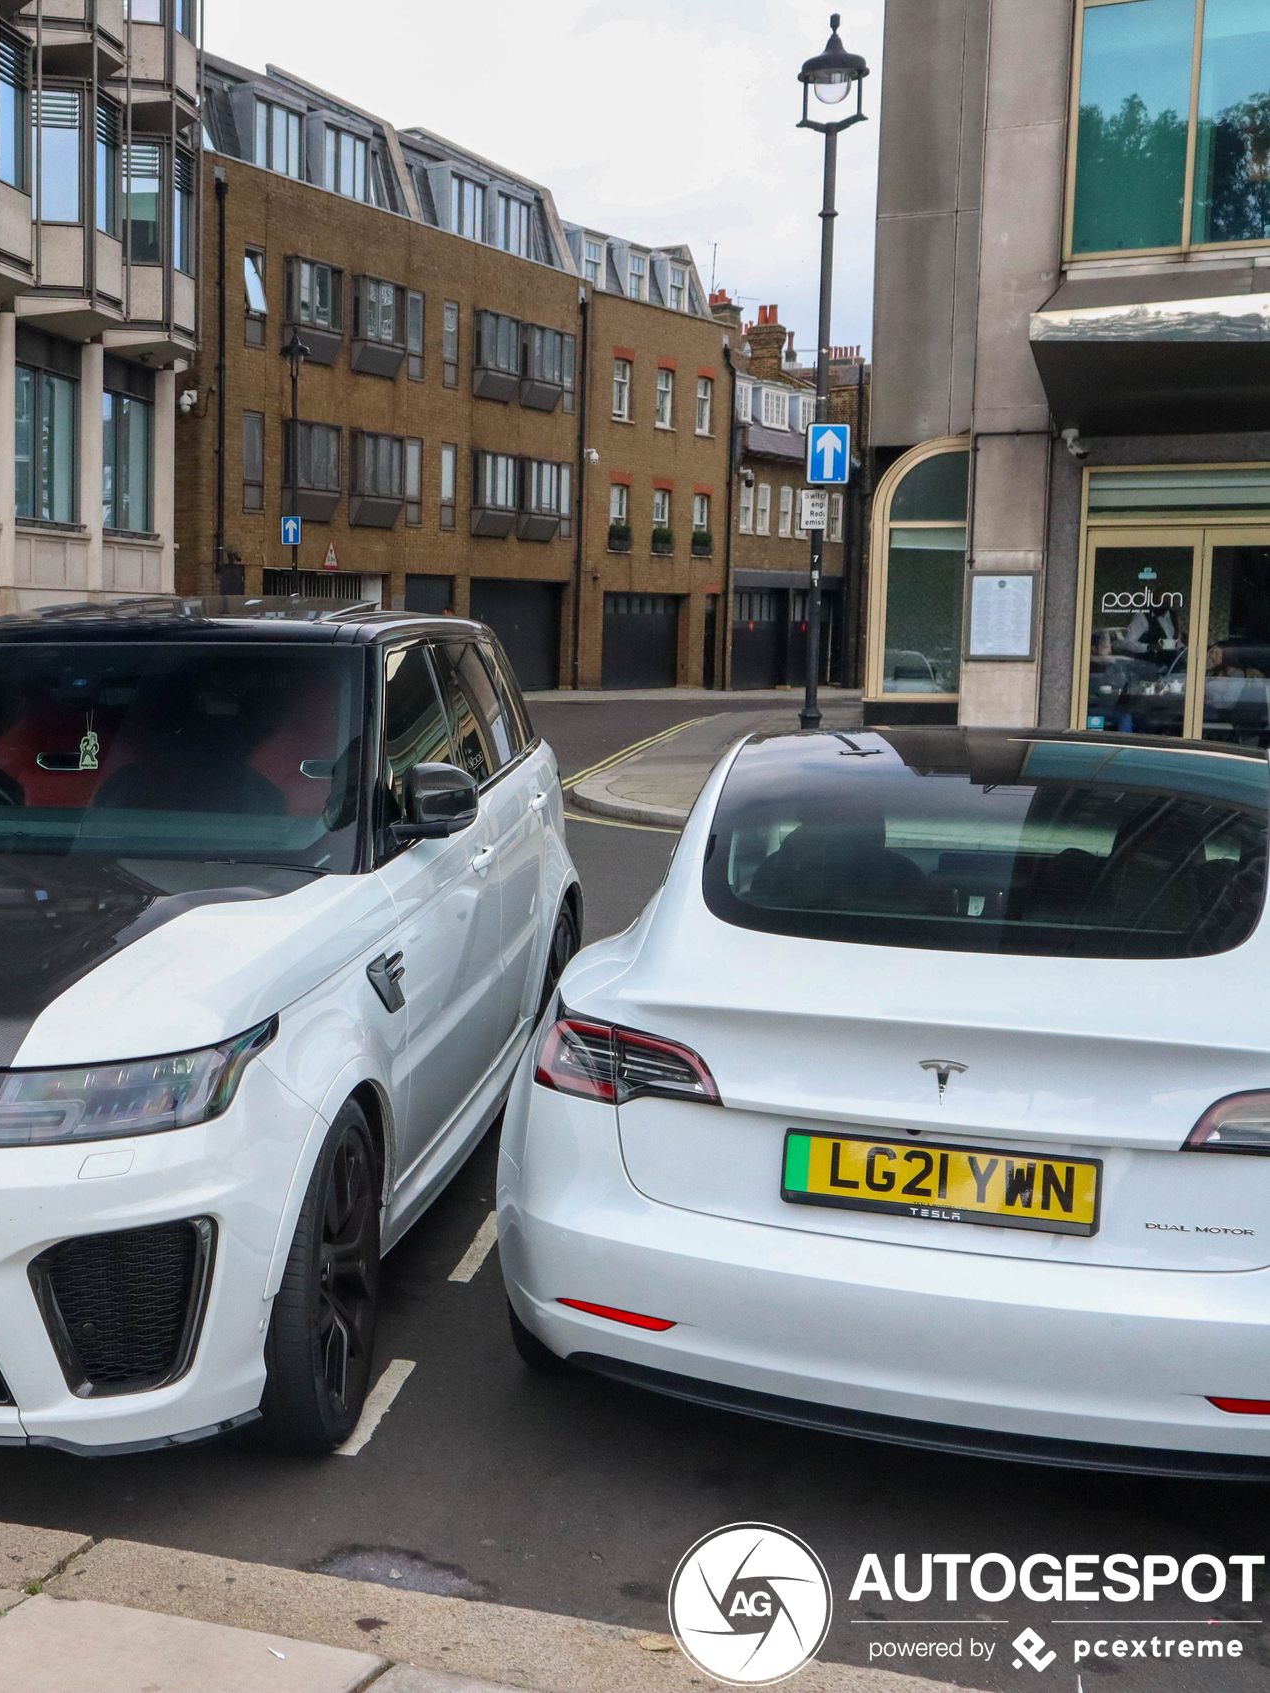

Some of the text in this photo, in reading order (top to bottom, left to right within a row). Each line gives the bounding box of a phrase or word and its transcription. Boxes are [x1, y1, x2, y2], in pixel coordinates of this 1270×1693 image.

[1101, 586, 1183, 613] podium
[829, 1142, 1076, 1213] LG21 YWN
[909, 1207, 961, 1220] TESLA
[1145, 1222, 1255, 1236] DUAL MOTOR
